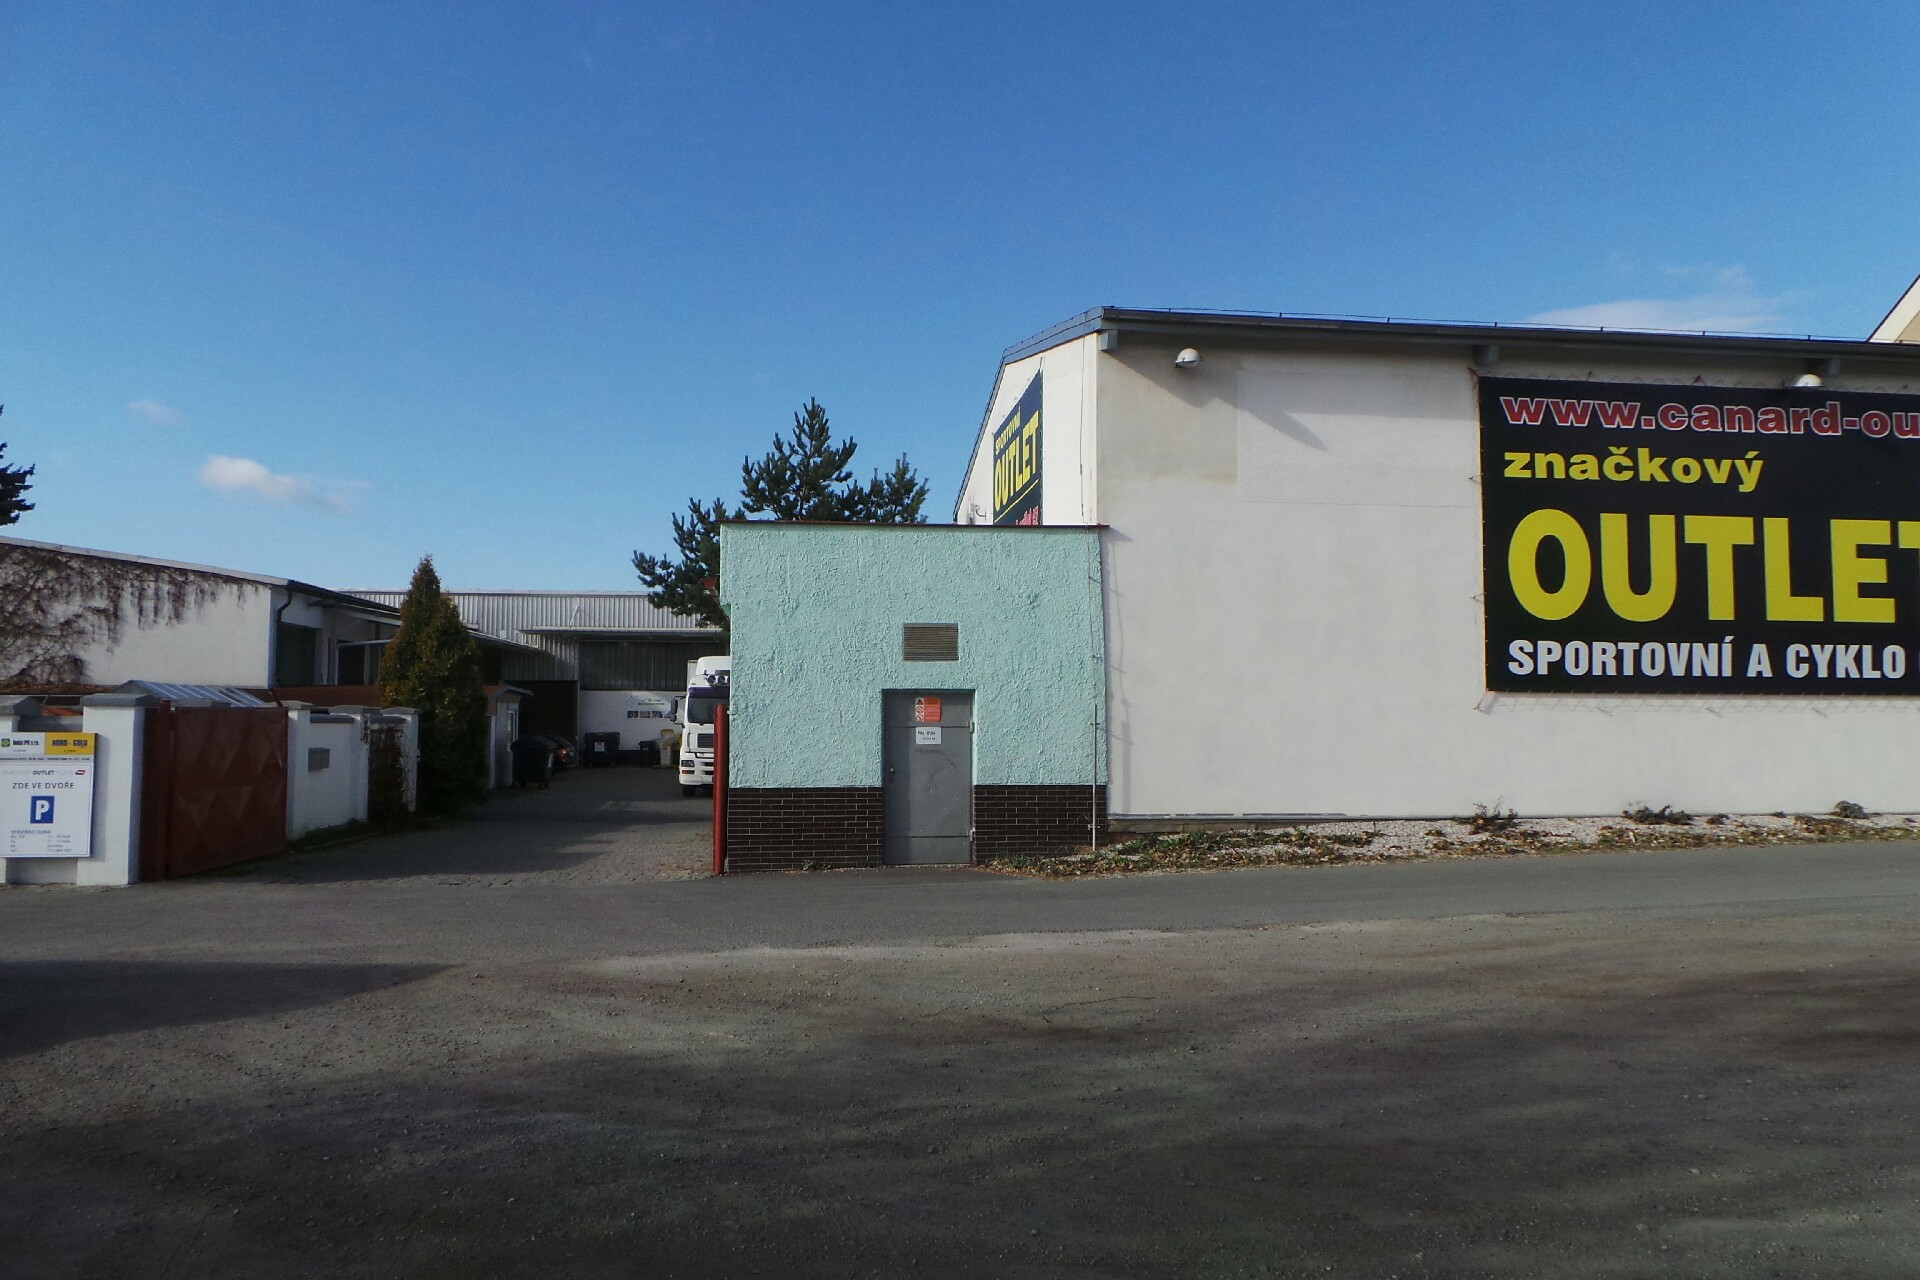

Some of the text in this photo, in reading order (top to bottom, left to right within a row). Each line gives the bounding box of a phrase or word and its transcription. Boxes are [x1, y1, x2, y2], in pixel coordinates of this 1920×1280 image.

[994, 409, 1039, 512] OUTLET
[1503, 446, 1764, 493] značkový
[1508, 636, 1906, 679] SPORTOVNÍ A CYKLO
[45, 780, 75, 789] DVOŘE
[35, 800, 50, 821] P
